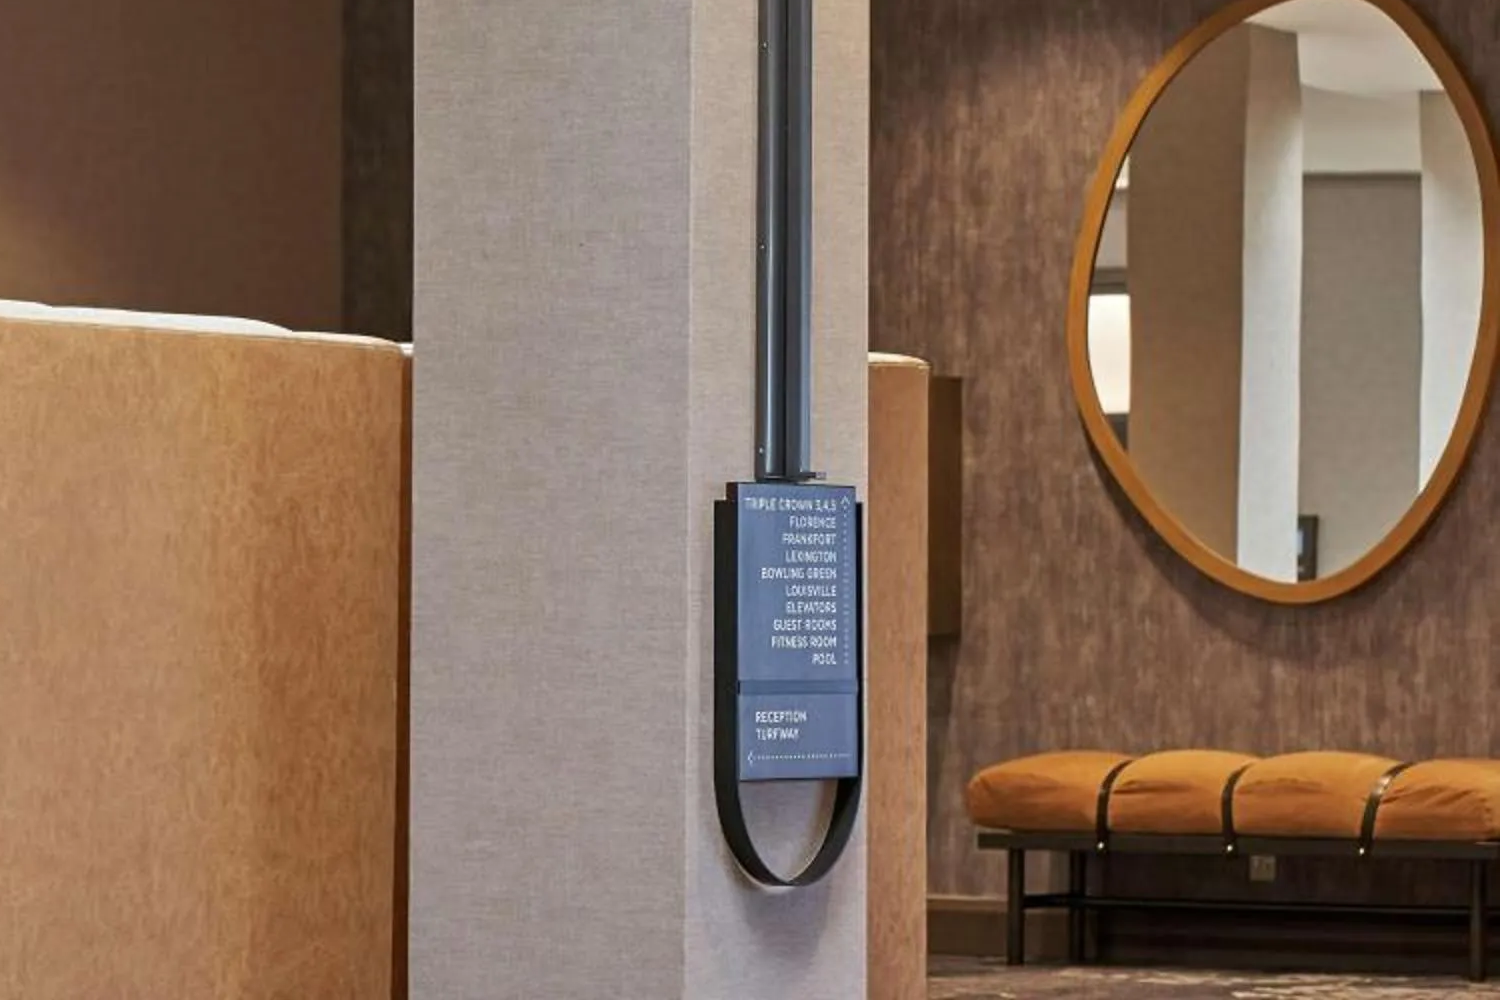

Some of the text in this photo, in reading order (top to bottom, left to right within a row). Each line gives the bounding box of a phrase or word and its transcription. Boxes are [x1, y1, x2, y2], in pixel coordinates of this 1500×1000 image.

[744, 497, 776, 511] TRIPLE
[778, 498, 812, 512] CROWN
[789, 515, 837, 529] FLORENCE
[781, 532, 837, 546] FRANKFORT
[785, 549, 837, 563] LEXINGTON
[760, 566, 837, 580] BOWLING GREEN
[785, 584, 837, 597] LOUISVILLE
[785, 600, 837, 614] ELEVATORS
[772, 618, 837, 632] GUEST ROOMS
[771, 634, 837, 649] FITNESS ROOM
[811, 652, 837, 665] POOL
[755, 710, 808, 723] RECEPTION
[755, 727, 800, 741] TURFWAY
